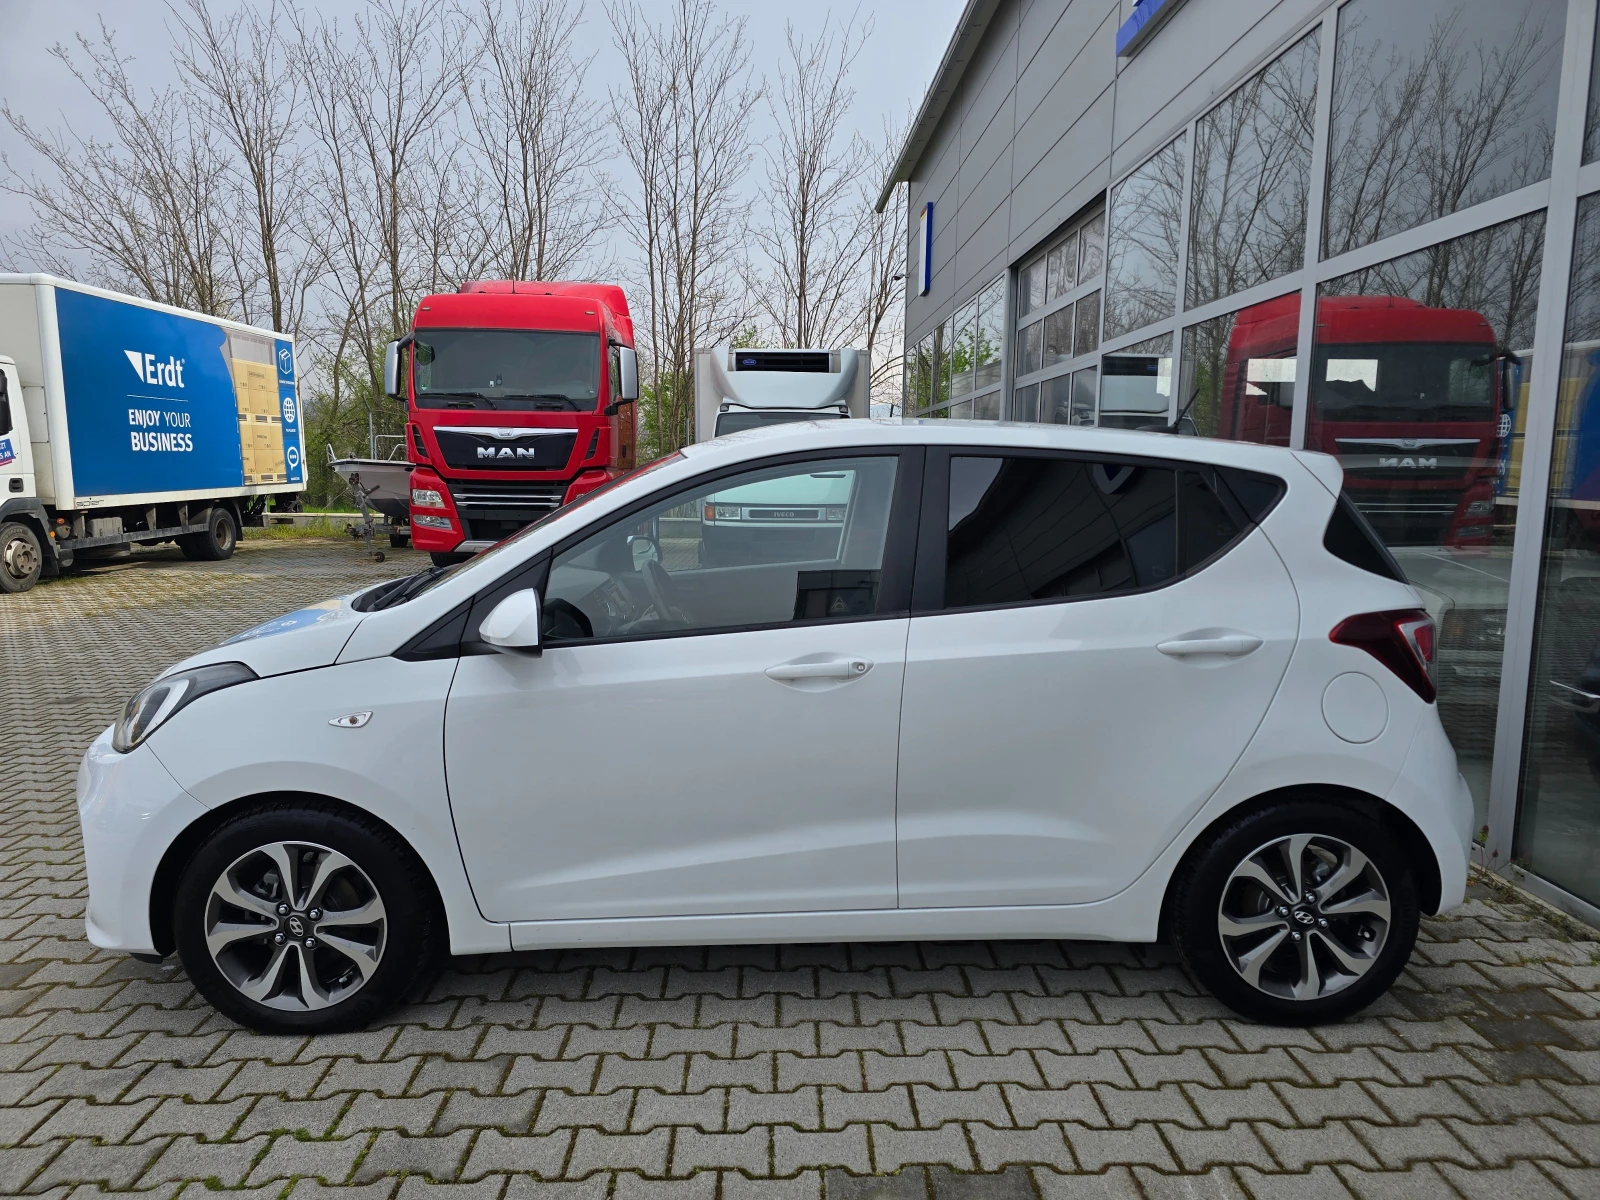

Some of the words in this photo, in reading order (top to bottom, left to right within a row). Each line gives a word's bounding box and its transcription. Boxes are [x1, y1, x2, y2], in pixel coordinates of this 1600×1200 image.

[145, 353, 185, 388] Erdt
[128, 408, 161, 429] ENJOY
[163, 411, 191, 428] YOUR
[130, 431, 194, 452] BUSINESS
[476, 446, 536, 460] MAN
